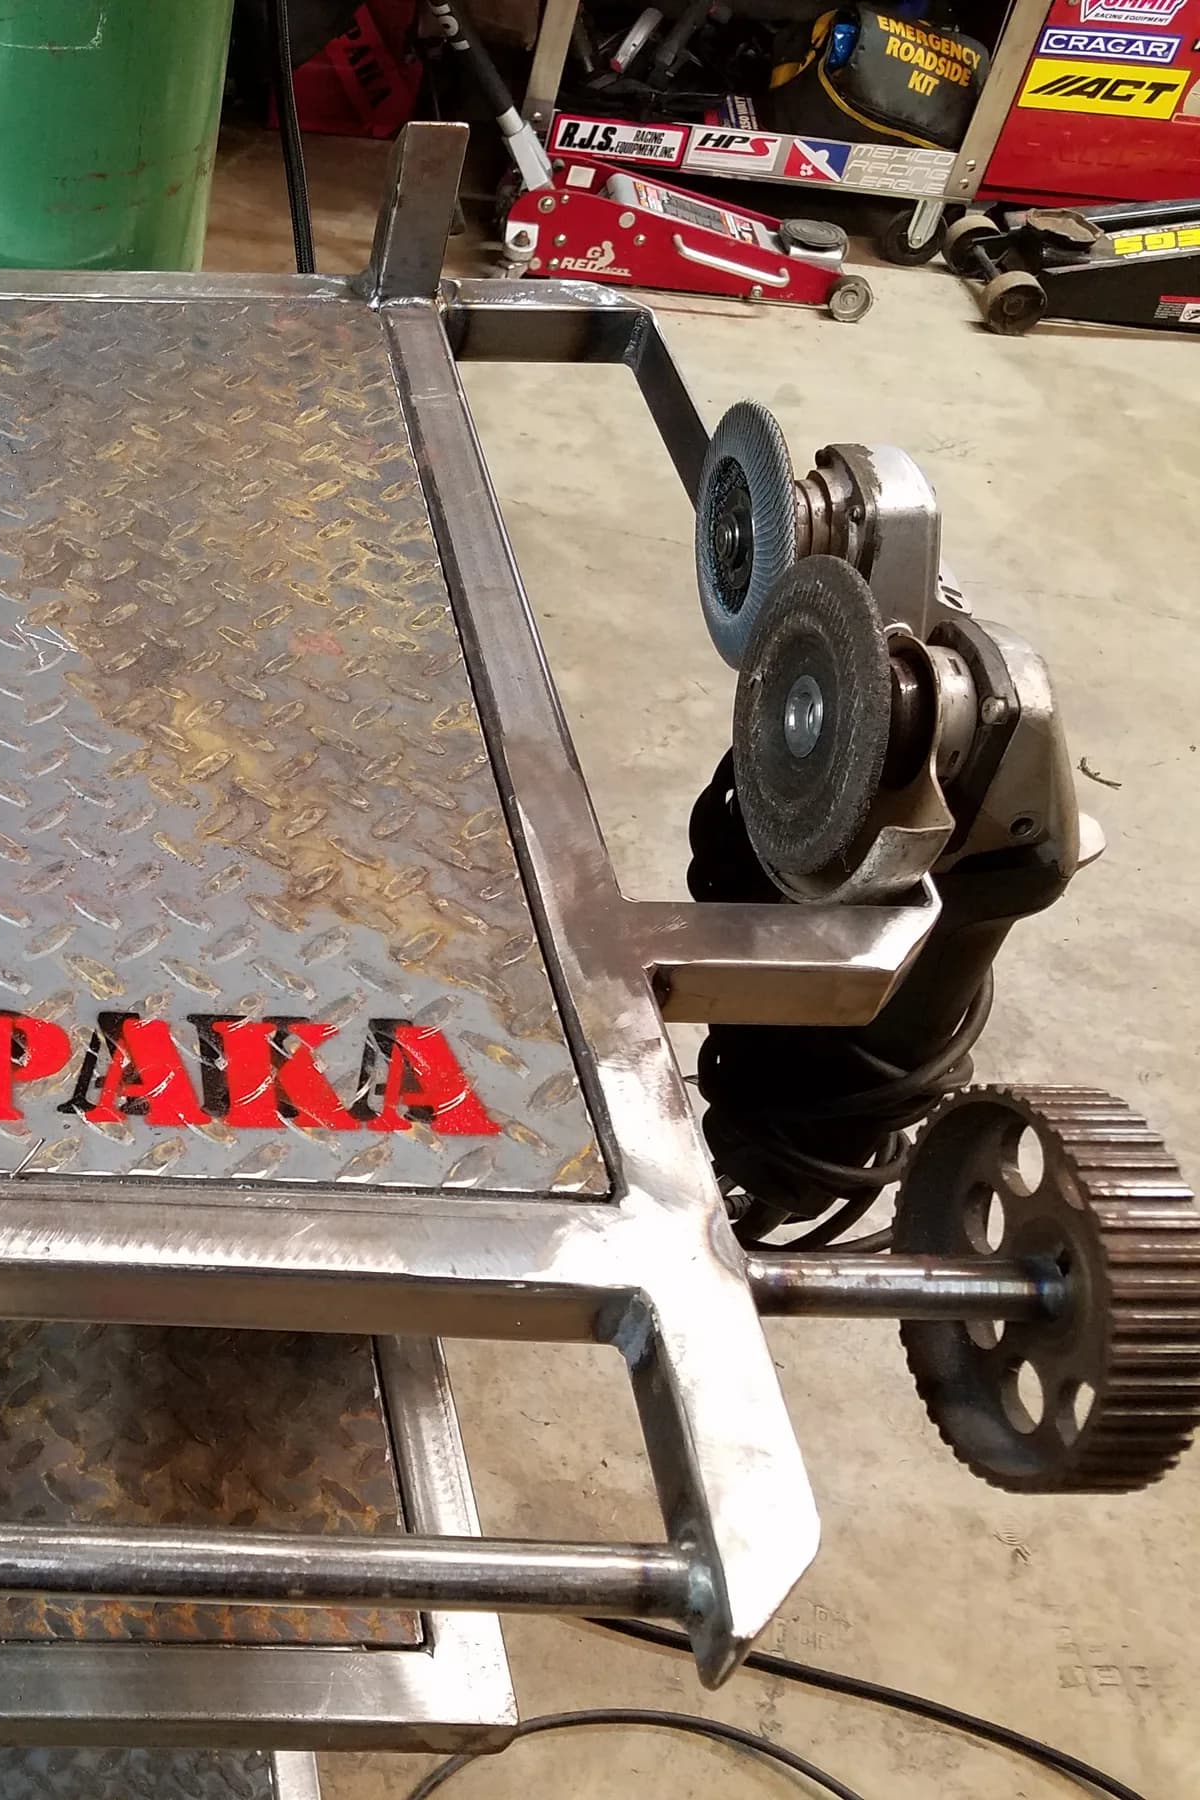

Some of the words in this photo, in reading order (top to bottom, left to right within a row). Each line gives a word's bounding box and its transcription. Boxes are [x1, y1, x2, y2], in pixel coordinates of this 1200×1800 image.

[1094, 12, 1123, 20] RACING
[1124, 14, 1169, 24] EQUIPMENT
[876, 15, 981, 70] EMERGENCY
[1049, 34, 1167, 57] CRAGAR
[885, 36, 972, 87] ROADSIDE
[908, 70, 940, 96] KIT
[558, 121, 614, 153] R.J.S.
[633, 129, 665, 145] RACING
[697, 132, 778, 156] HPS
[851, 145, 956, 166] MEXICO
[847, 160, 951, 180] RACING
[841, 174, 946, 194] LEAGUE
